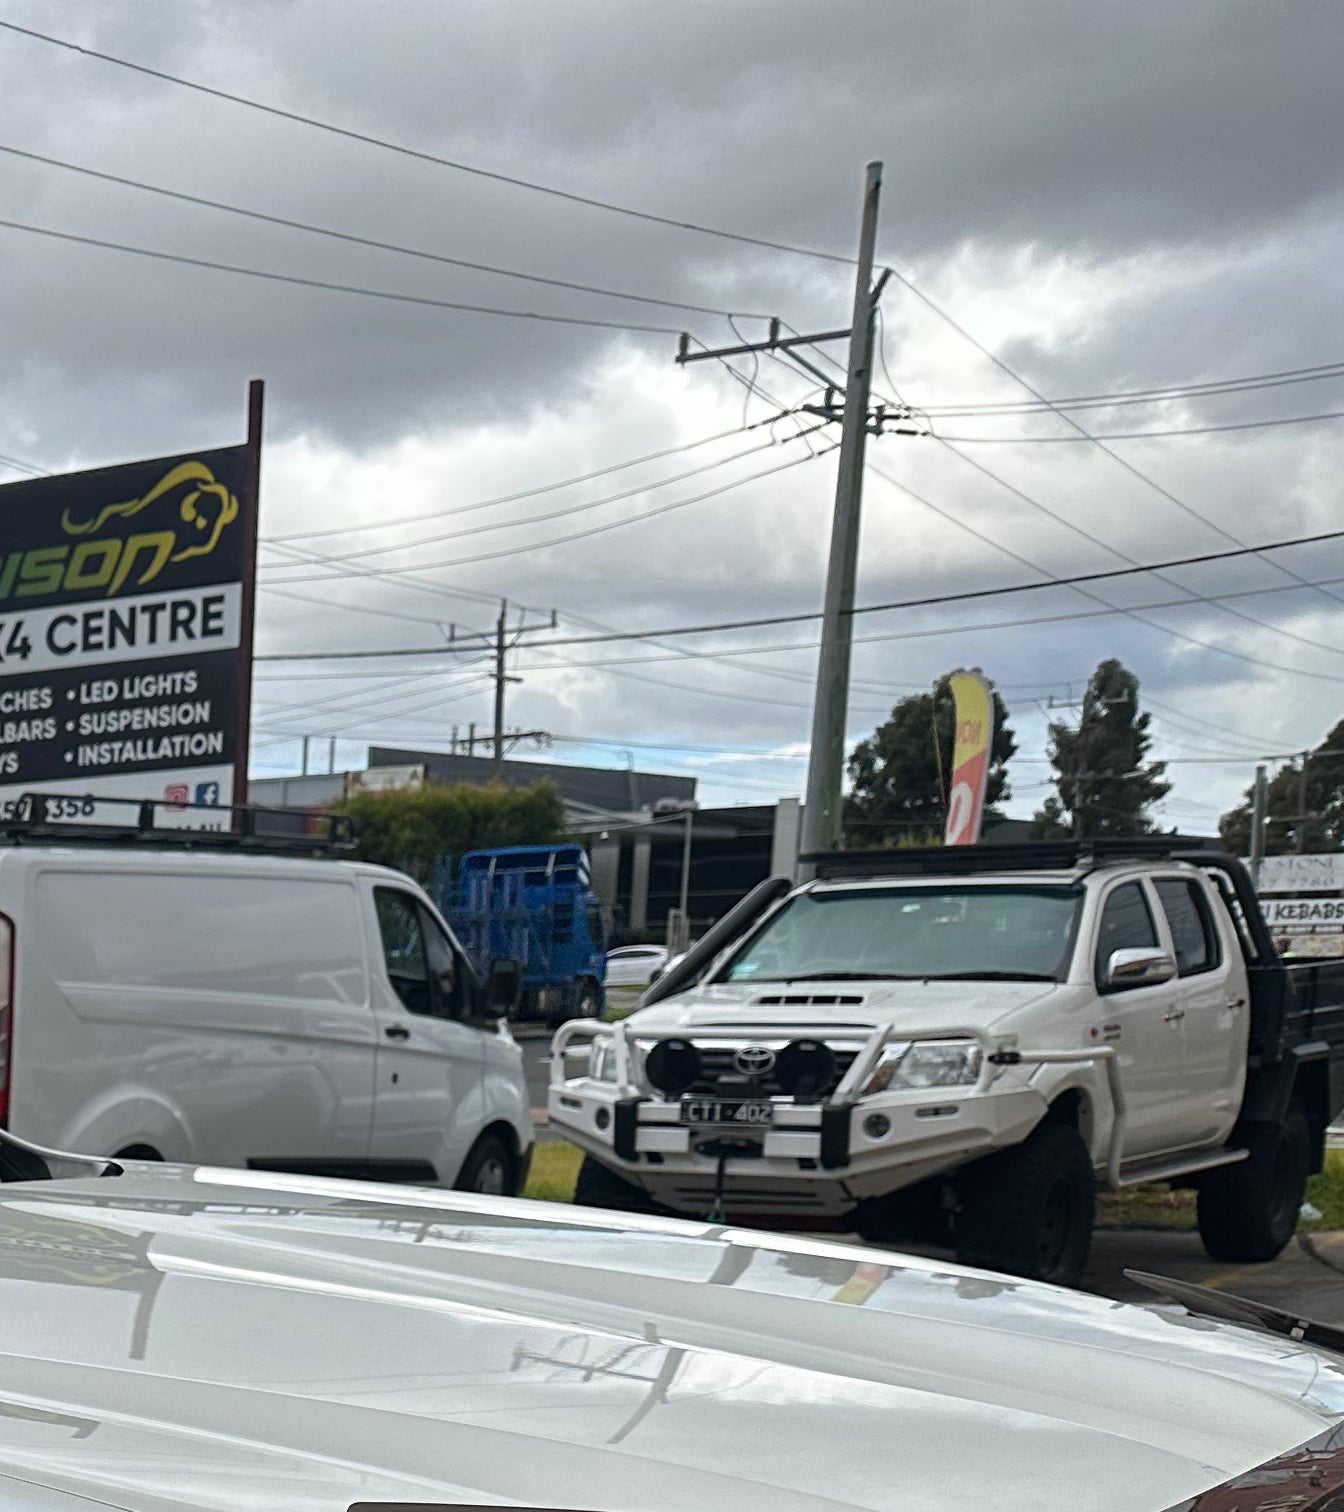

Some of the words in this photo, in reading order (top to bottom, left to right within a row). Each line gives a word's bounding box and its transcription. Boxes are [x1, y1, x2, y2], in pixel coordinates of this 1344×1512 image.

[46, 594, 226, 656] CENTRE
[80, 681, 119, 705] LED
[123, 670, 199, 701] LIGHTS
[78, 701, 211, 736] SUSPENSION
[77, 731, 224, 767] INSTALLATION
